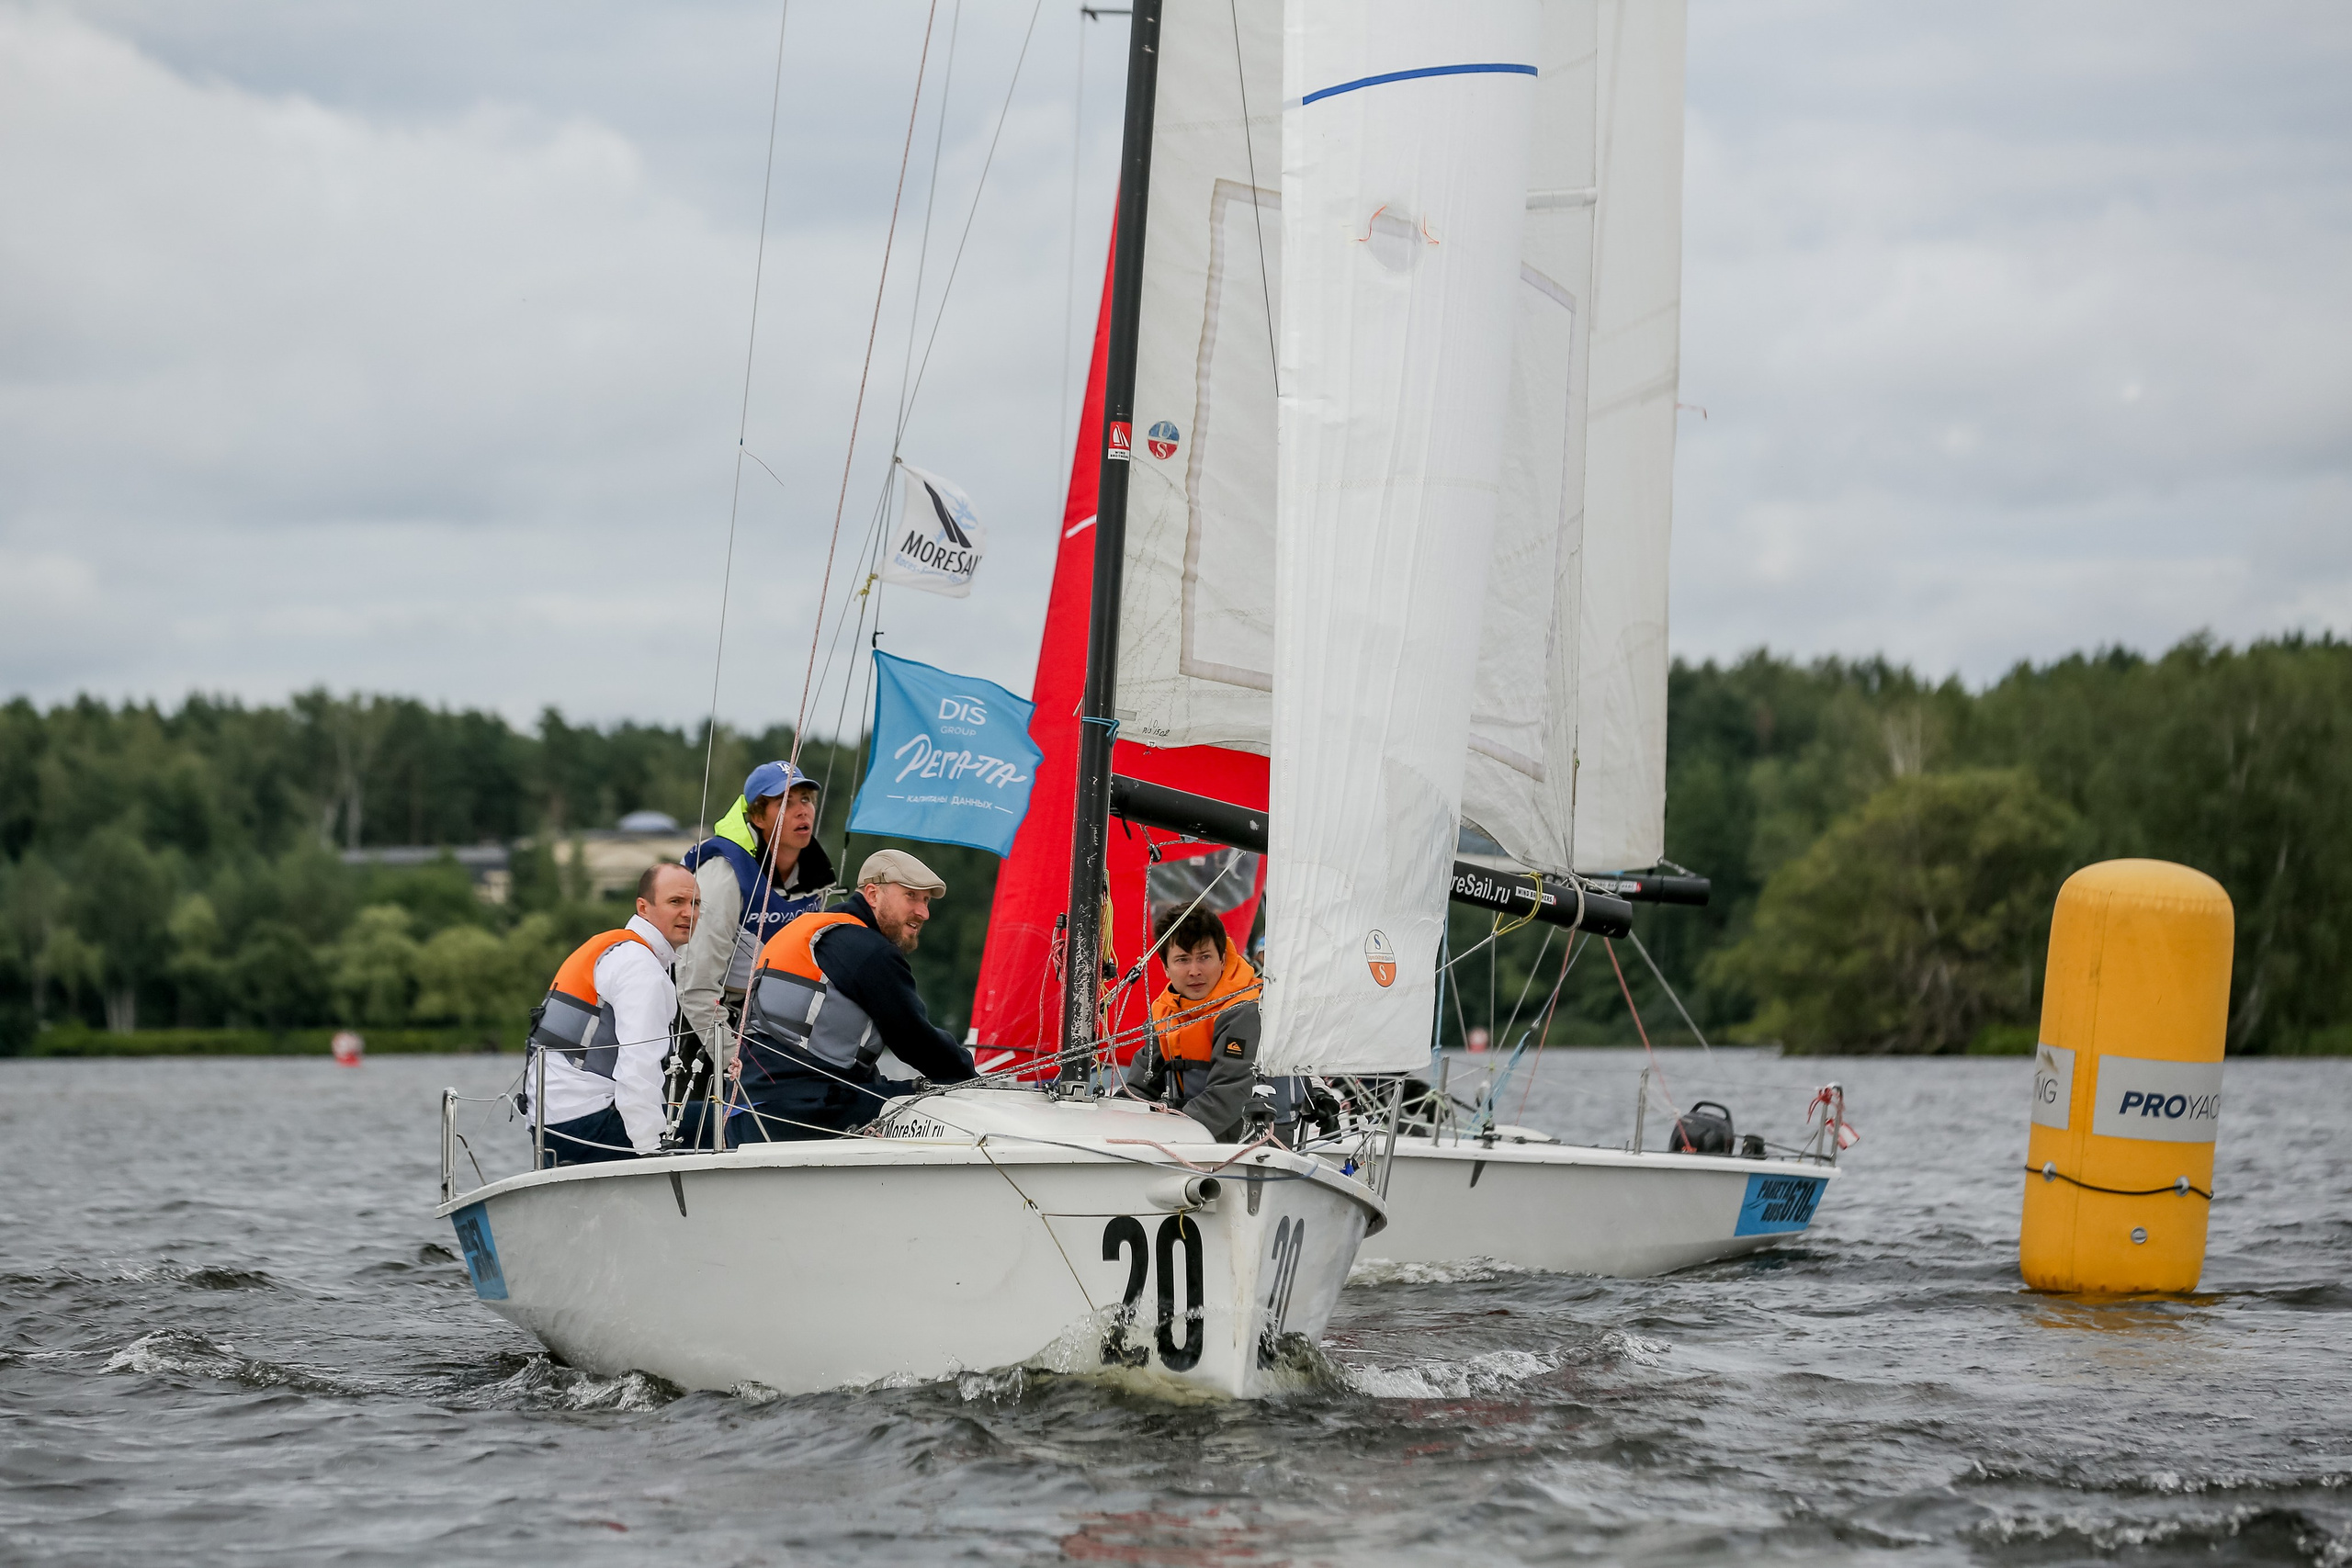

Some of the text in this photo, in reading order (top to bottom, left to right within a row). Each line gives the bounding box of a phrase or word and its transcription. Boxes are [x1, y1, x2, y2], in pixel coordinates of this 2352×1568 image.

[938, 697, 988, 726] DIS
[940, 726, 977, 737] GROUP
[950, 795, 993, 810] ДАННЫХ
[1102, 1214, 1204, 1373] 20
